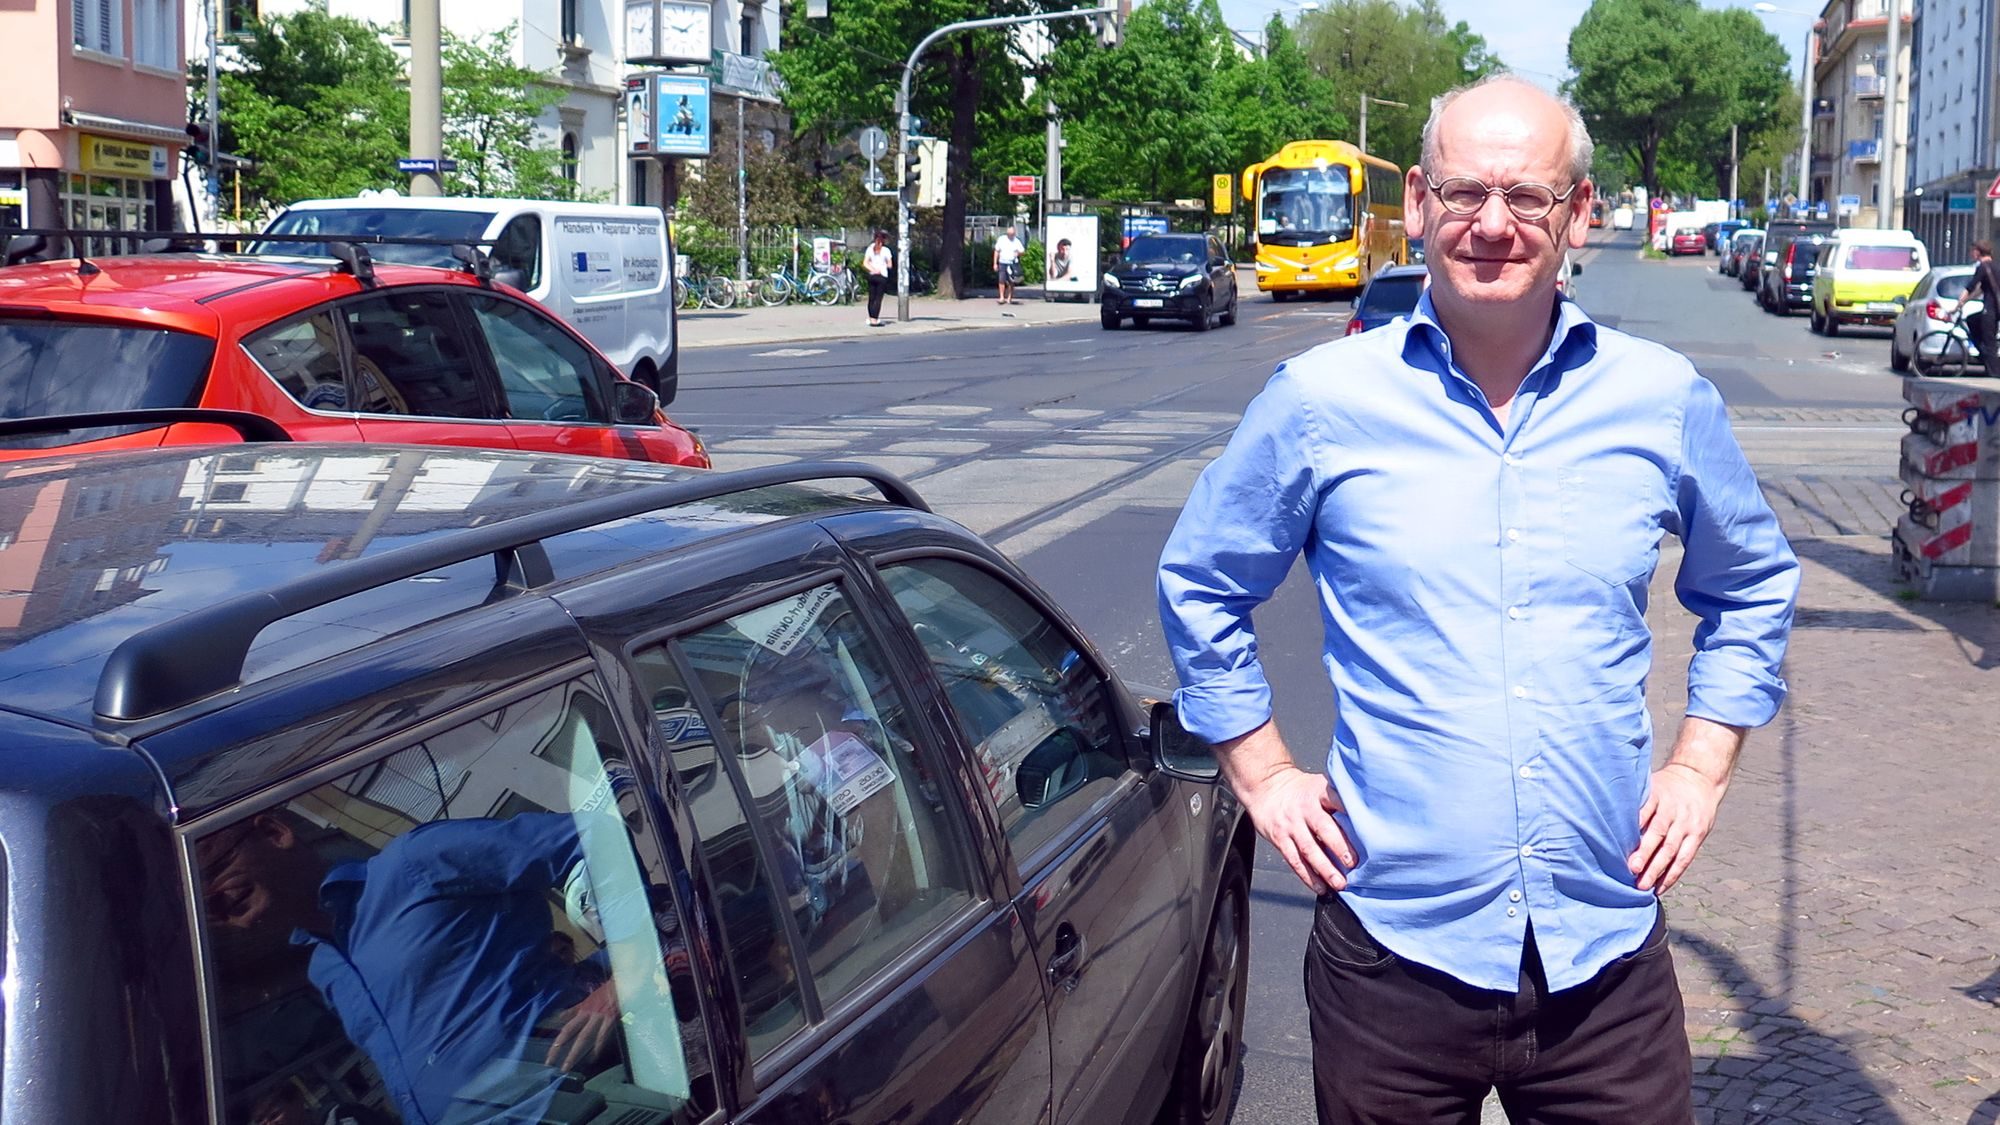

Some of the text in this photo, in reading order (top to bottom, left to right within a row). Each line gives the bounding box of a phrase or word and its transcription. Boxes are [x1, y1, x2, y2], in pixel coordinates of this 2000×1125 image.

[563, 222, 656, 236] Handwerk Reparatur Service
[631, 257, 658, 269] Arbeitsplatz
